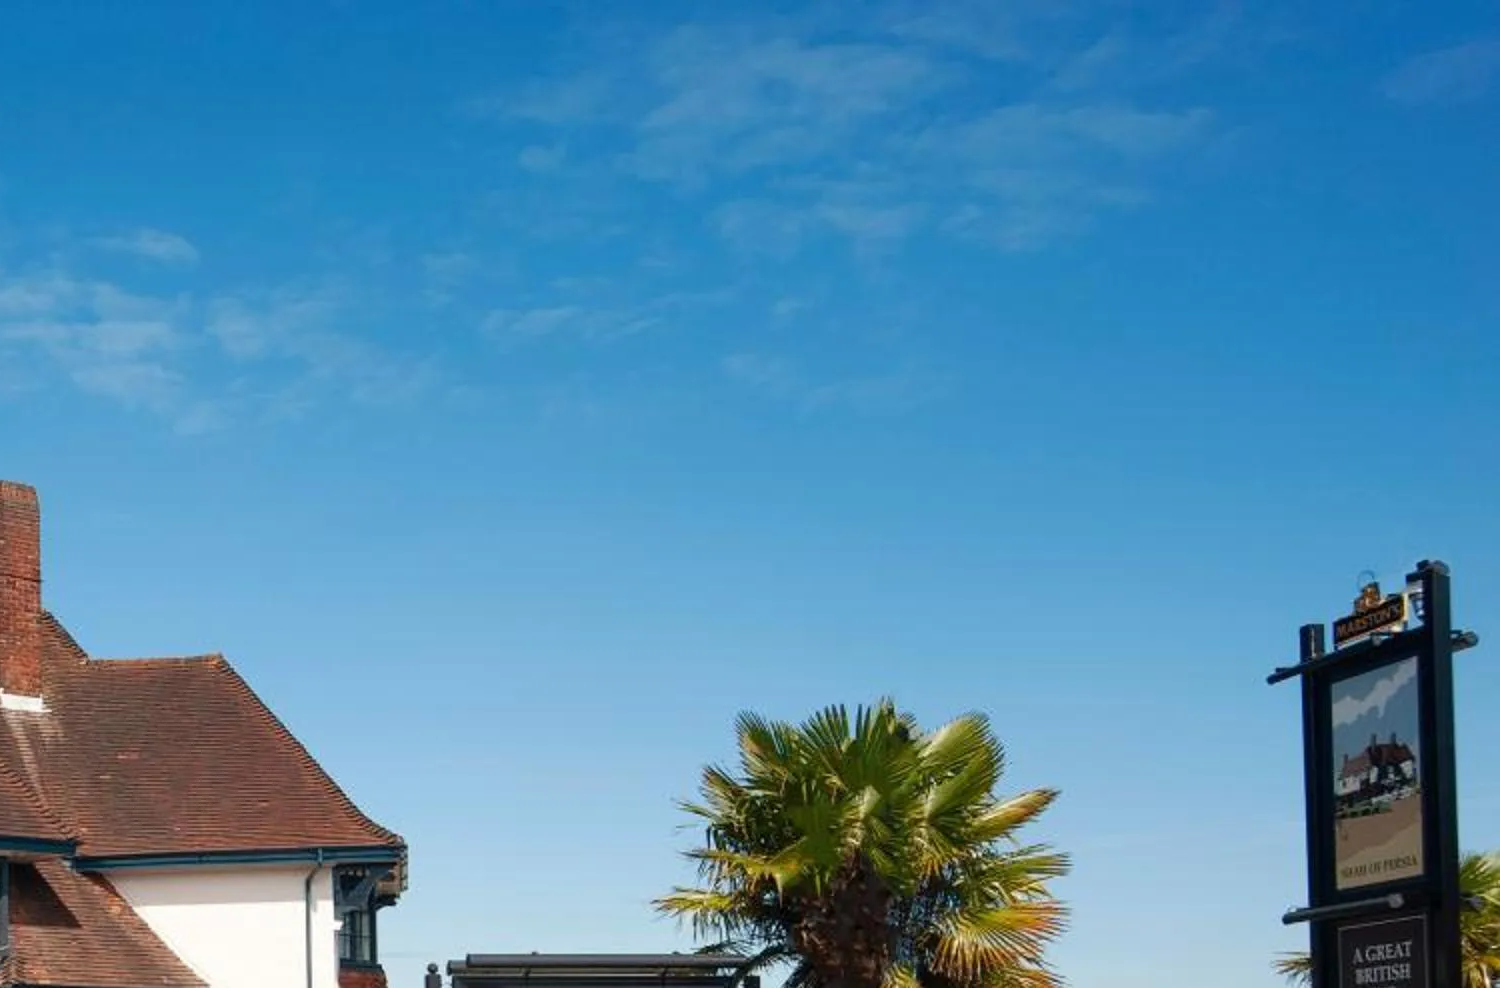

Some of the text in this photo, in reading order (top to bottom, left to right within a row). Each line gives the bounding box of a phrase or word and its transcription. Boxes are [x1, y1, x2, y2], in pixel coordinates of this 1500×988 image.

[1353, 941, 1412, 965] A GREAT
[1355, 963, 1411, 985] BRITISH
